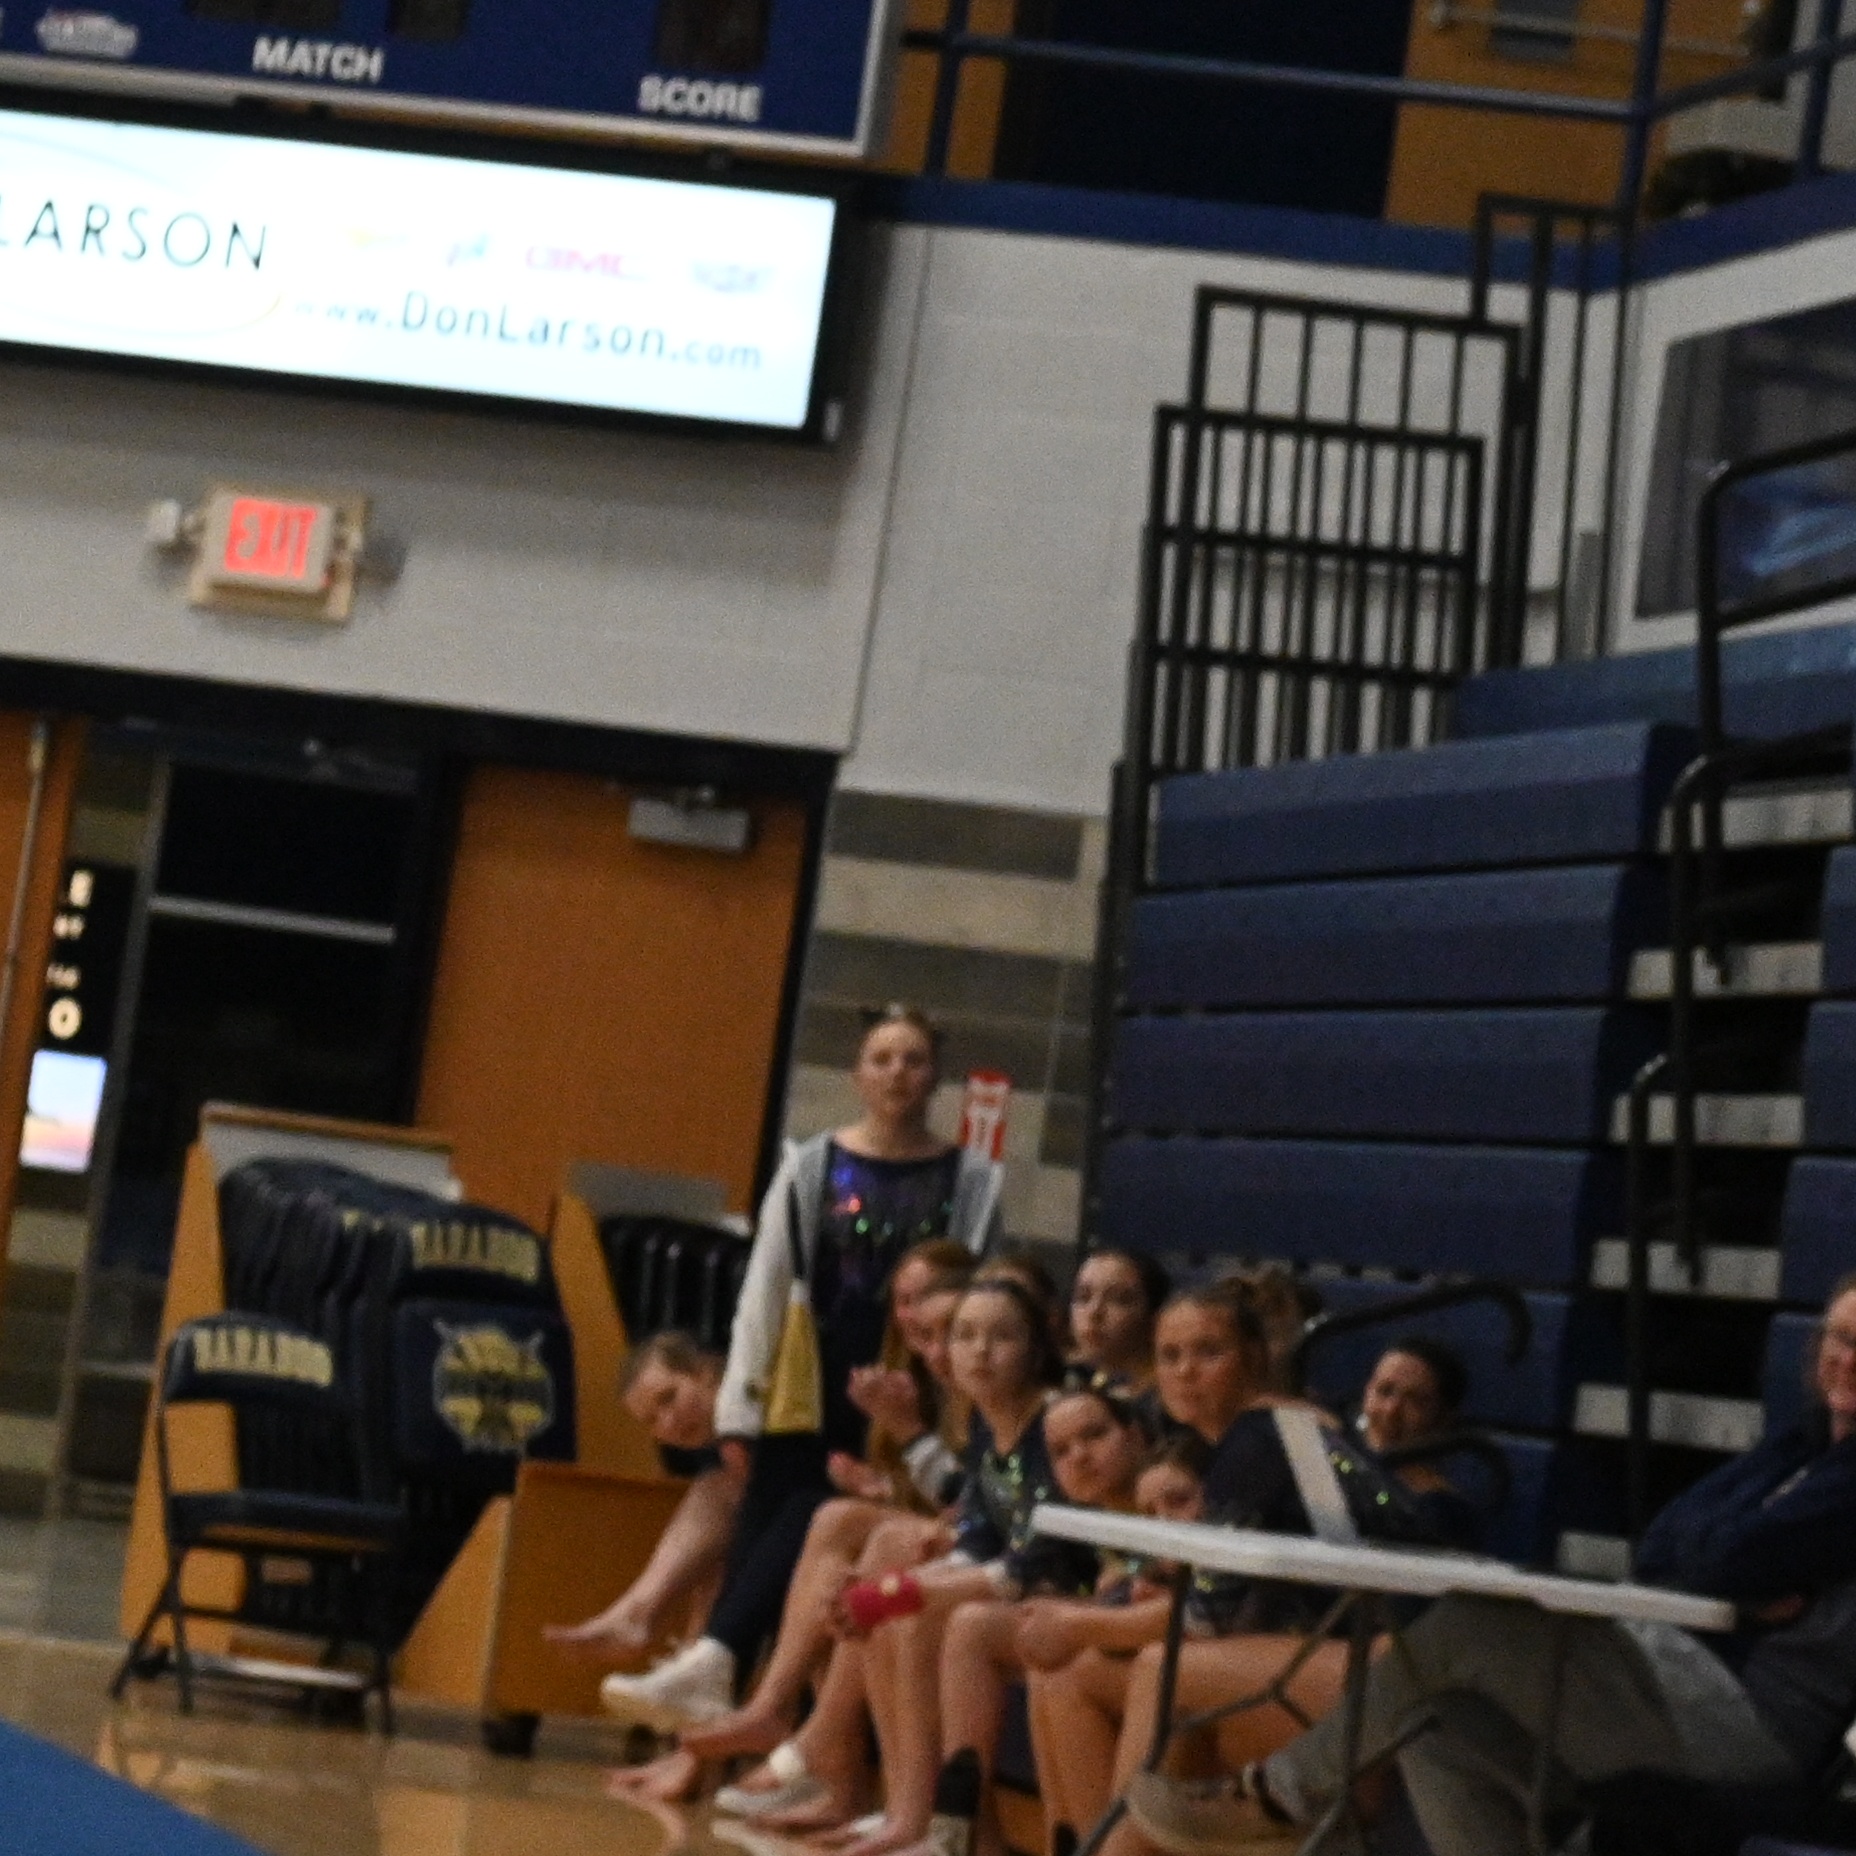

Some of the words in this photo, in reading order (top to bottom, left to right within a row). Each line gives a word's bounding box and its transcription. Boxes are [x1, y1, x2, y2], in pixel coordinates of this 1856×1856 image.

[253, 36, 384, 84] MATCH
[638, 75, 761, 122] SCORE
[293, 289, 763, 371] www.DonLarson.com
[224, 497, 318, 579] EXIT
